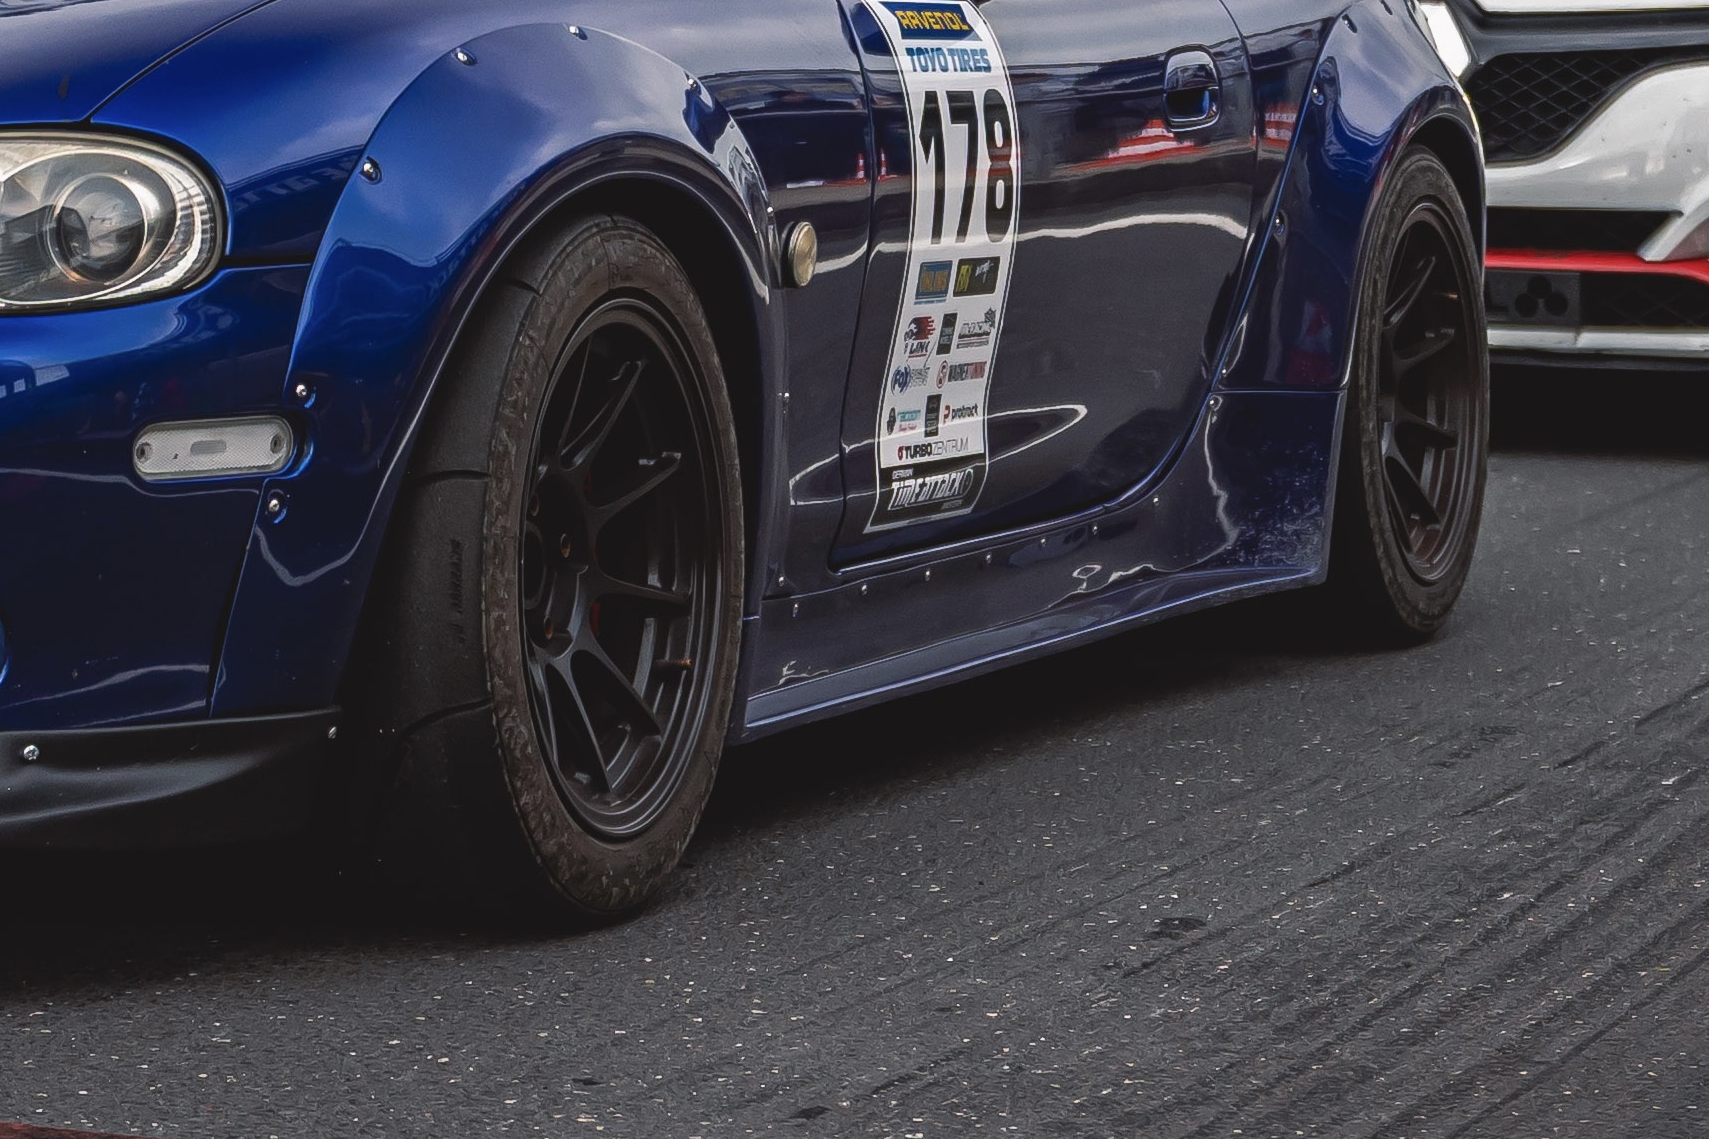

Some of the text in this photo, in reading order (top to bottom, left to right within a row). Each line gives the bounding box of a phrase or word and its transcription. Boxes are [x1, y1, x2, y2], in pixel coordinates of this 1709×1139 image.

[894, 10, 971, 31] RAVENOL
[905, 47, 992, 73] TOYO TIRES
[918, 88, 1015, 246] 178
